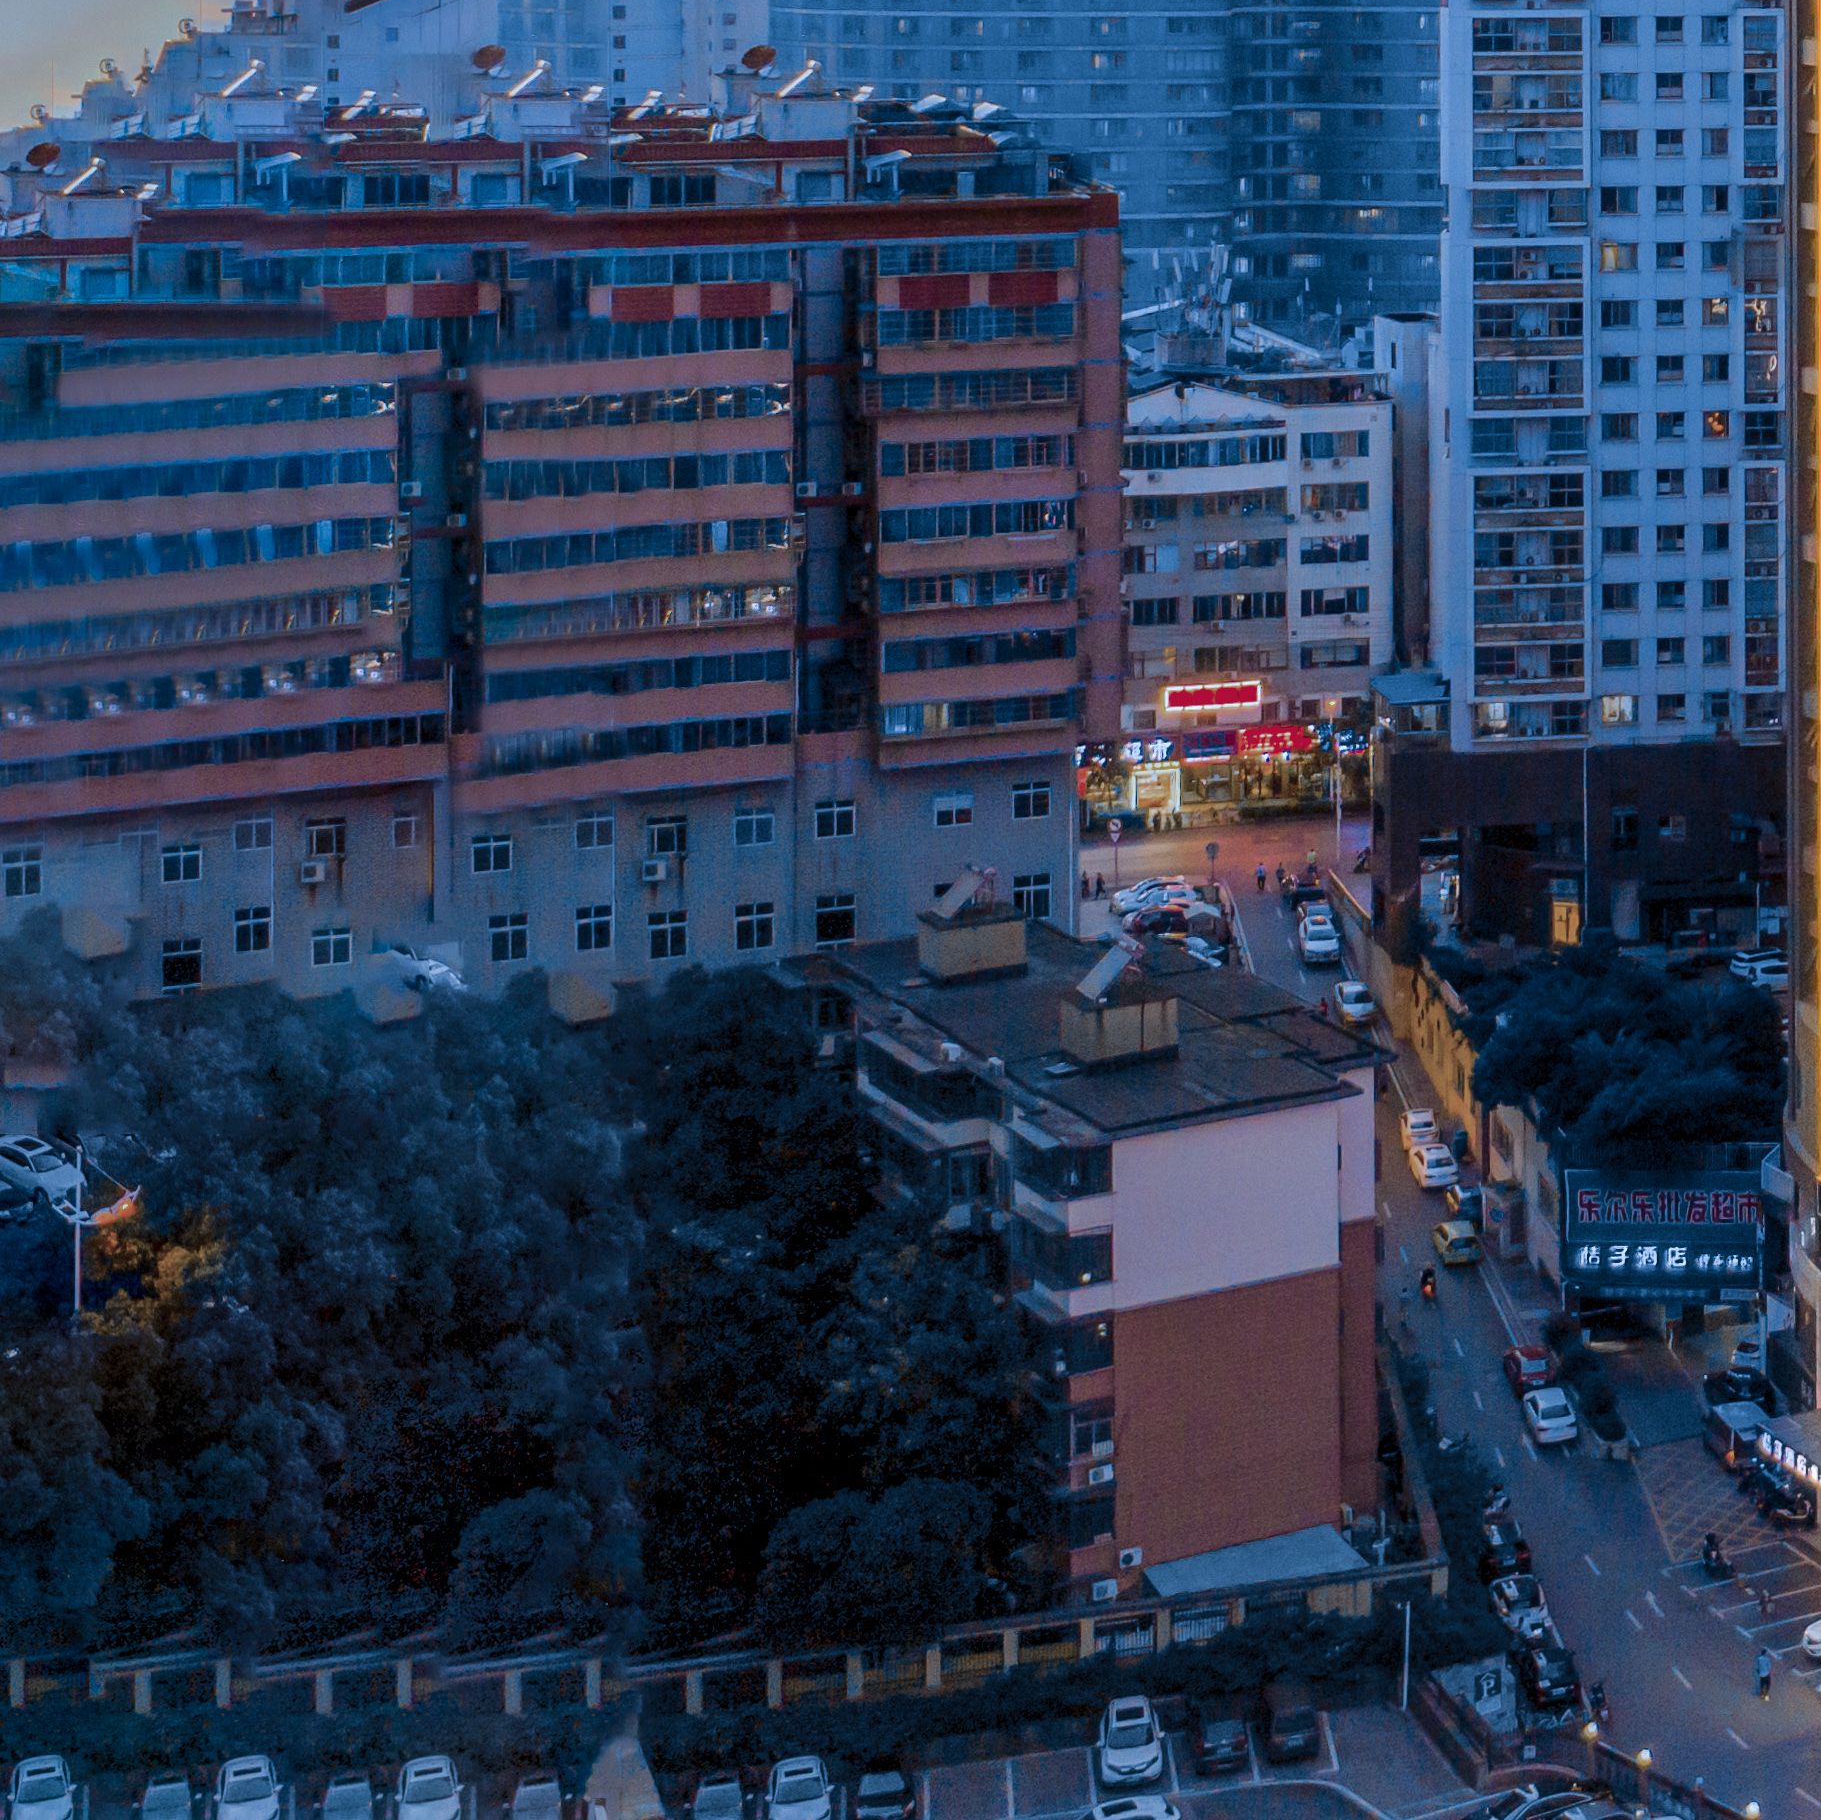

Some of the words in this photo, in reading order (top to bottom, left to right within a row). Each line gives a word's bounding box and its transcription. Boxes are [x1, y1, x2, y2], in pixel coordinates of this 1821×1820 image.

[1578, 1189, 1764, 1224] 乐尔乐批发超市
[1579, 1245, 1688, 1268] 桔子酒店
